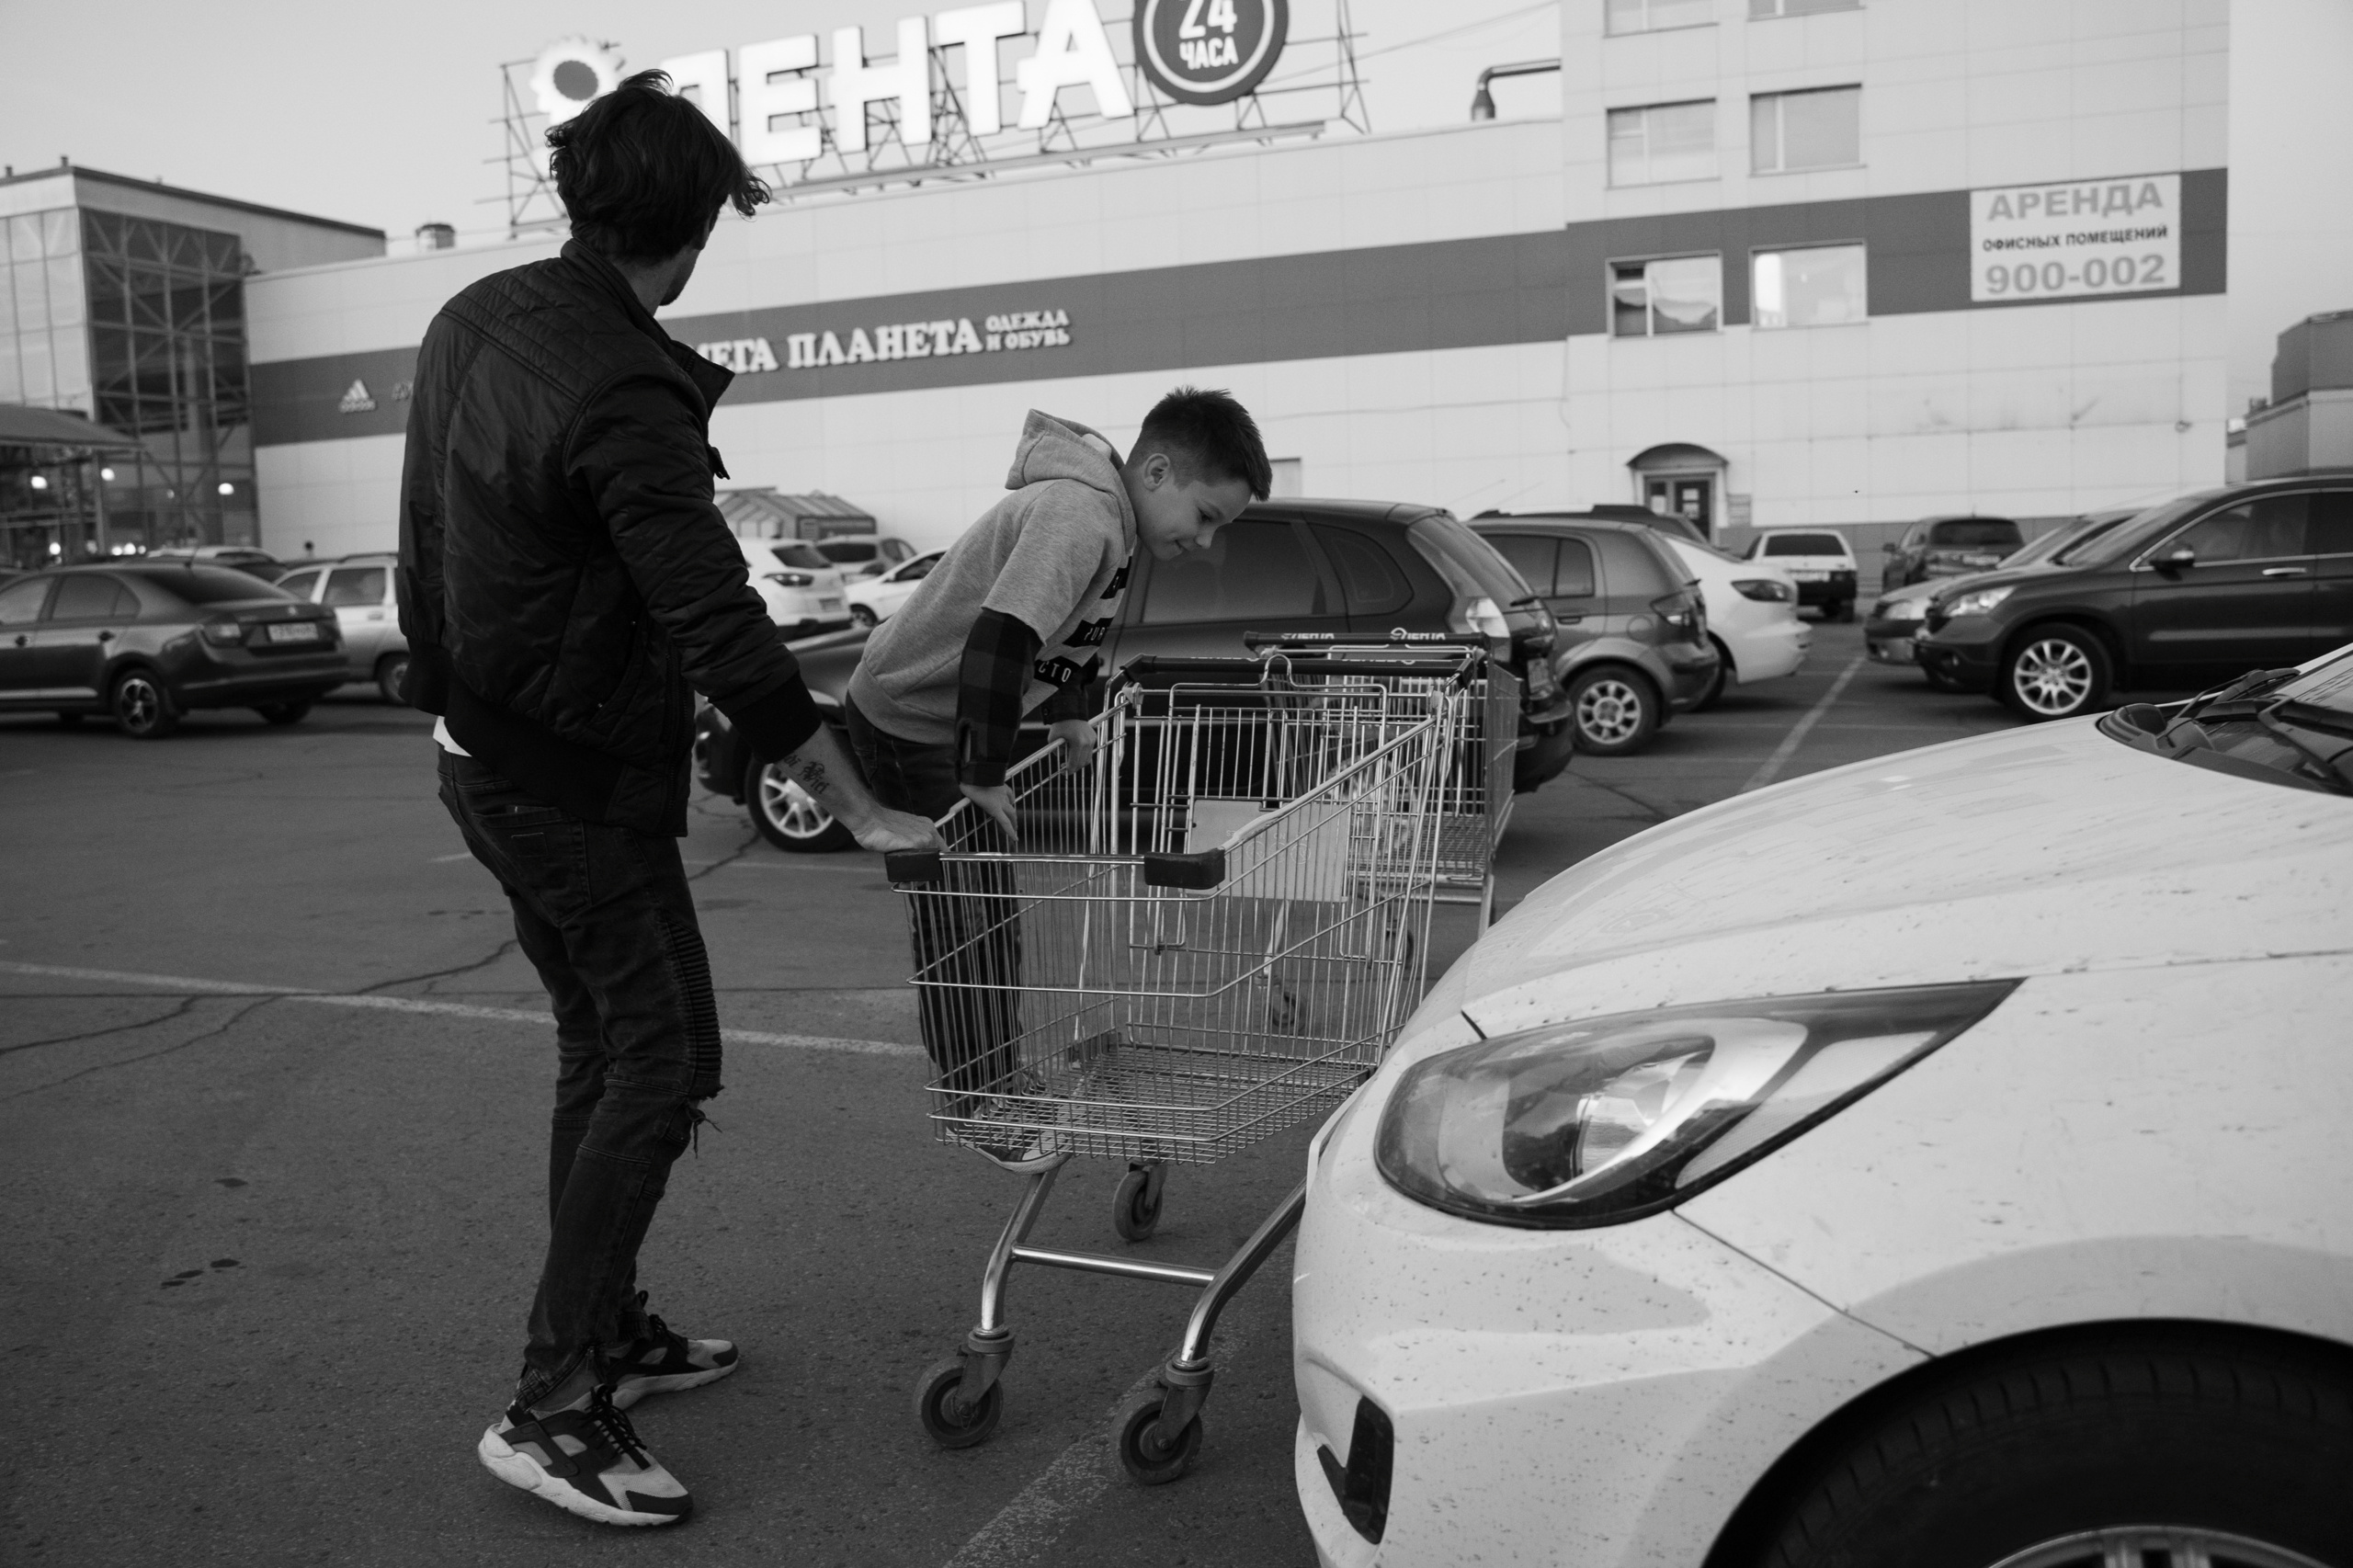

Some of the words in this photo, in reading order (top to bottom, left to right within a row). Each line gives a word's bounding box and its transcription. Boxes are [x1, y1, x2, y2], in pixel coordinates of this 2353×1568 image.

[1178, 0, 1238, 40] 24
[1179, 36, 1239, 70] ЧАСА
[1987, 181, 2164, 222] АРЕНДА
[1983, 233, 2061, 252] ОФИСНЫХ
[2065, 223, 2168, 245] ПОМЕЩЕНИЙ
[1985, 254, 2165, 294] 900-002
[984, 308, 1070, 333] ОДЕЖДА
[1004, 327, 1071, 350] ОБУВЬ
[788, 317, 983, 369] ПЛАНЕТА
